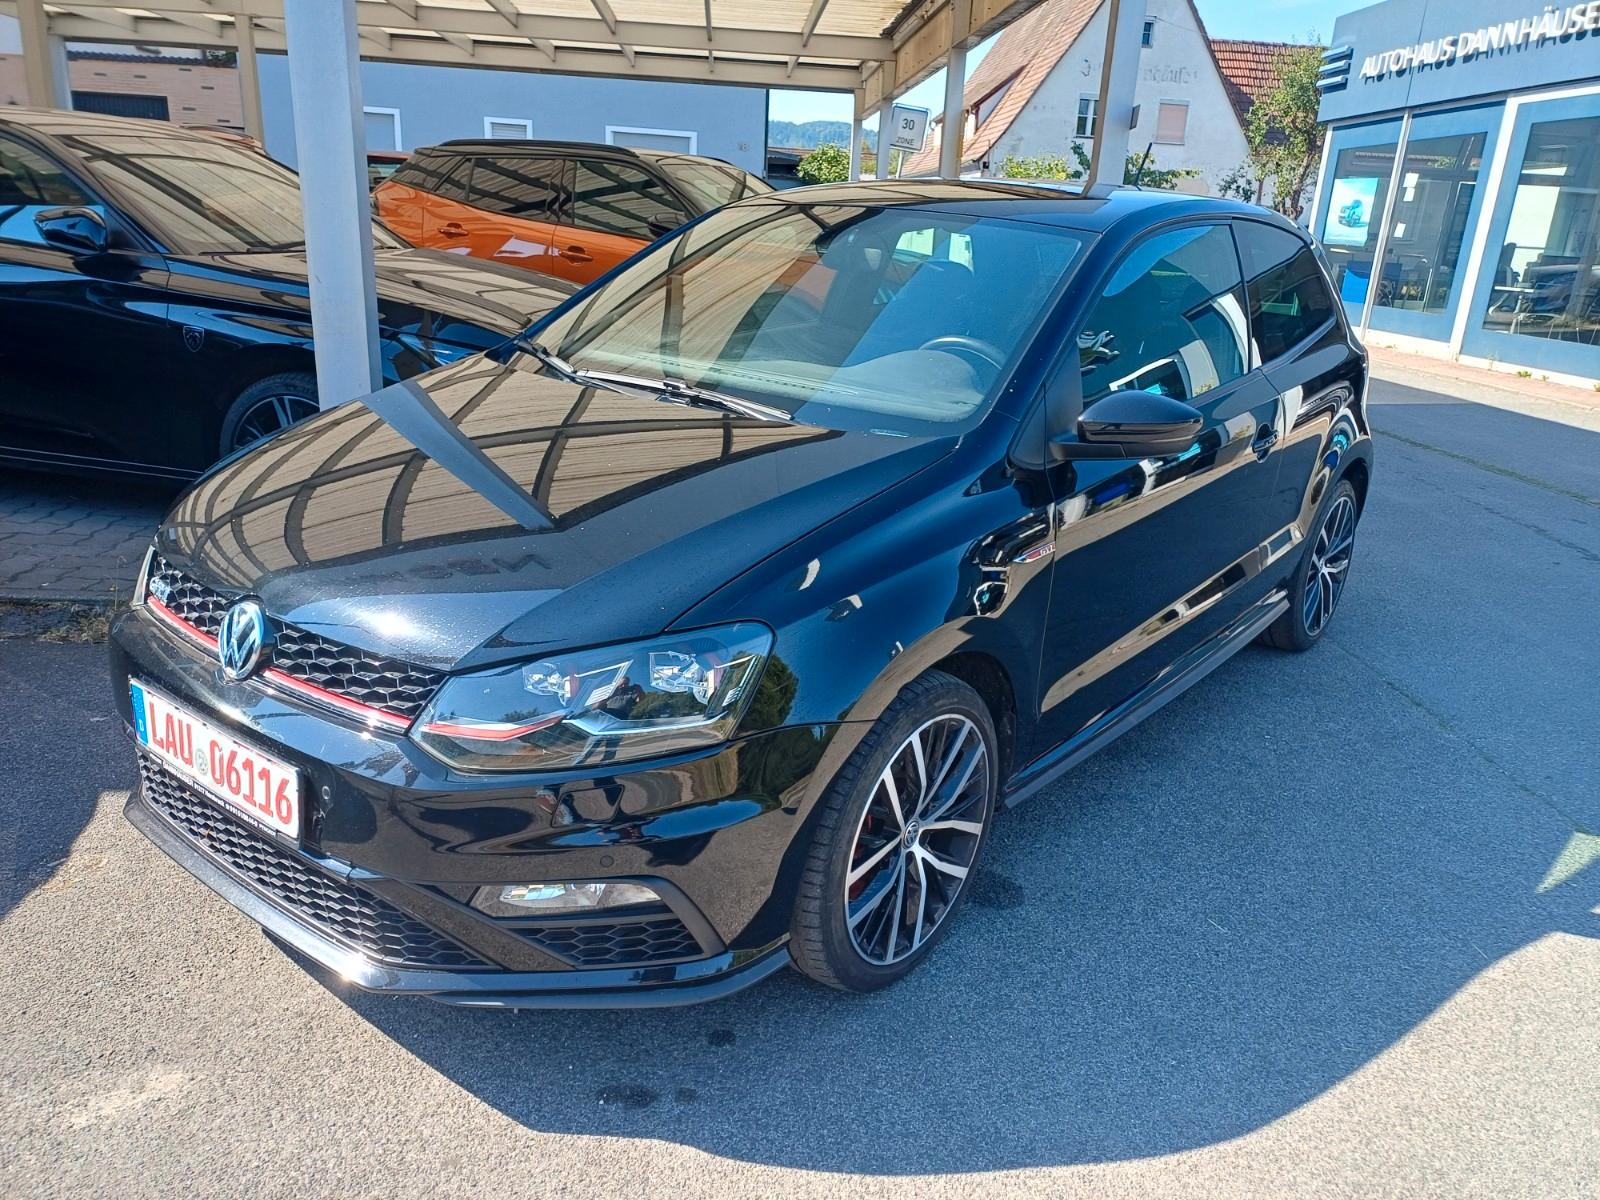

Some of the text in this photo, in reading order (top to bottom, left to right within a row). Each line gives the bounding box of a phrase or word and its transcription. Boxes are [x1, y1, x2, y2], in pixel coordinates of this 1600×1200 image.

[1359, 35, 1457, 80] AUTOHAUS
[902, 118, 915, 130] 30
[896, 136, 915, 146] ZONE
[149, 701, 194, 768] LAU
[209, 739, 293, 825] 06116
